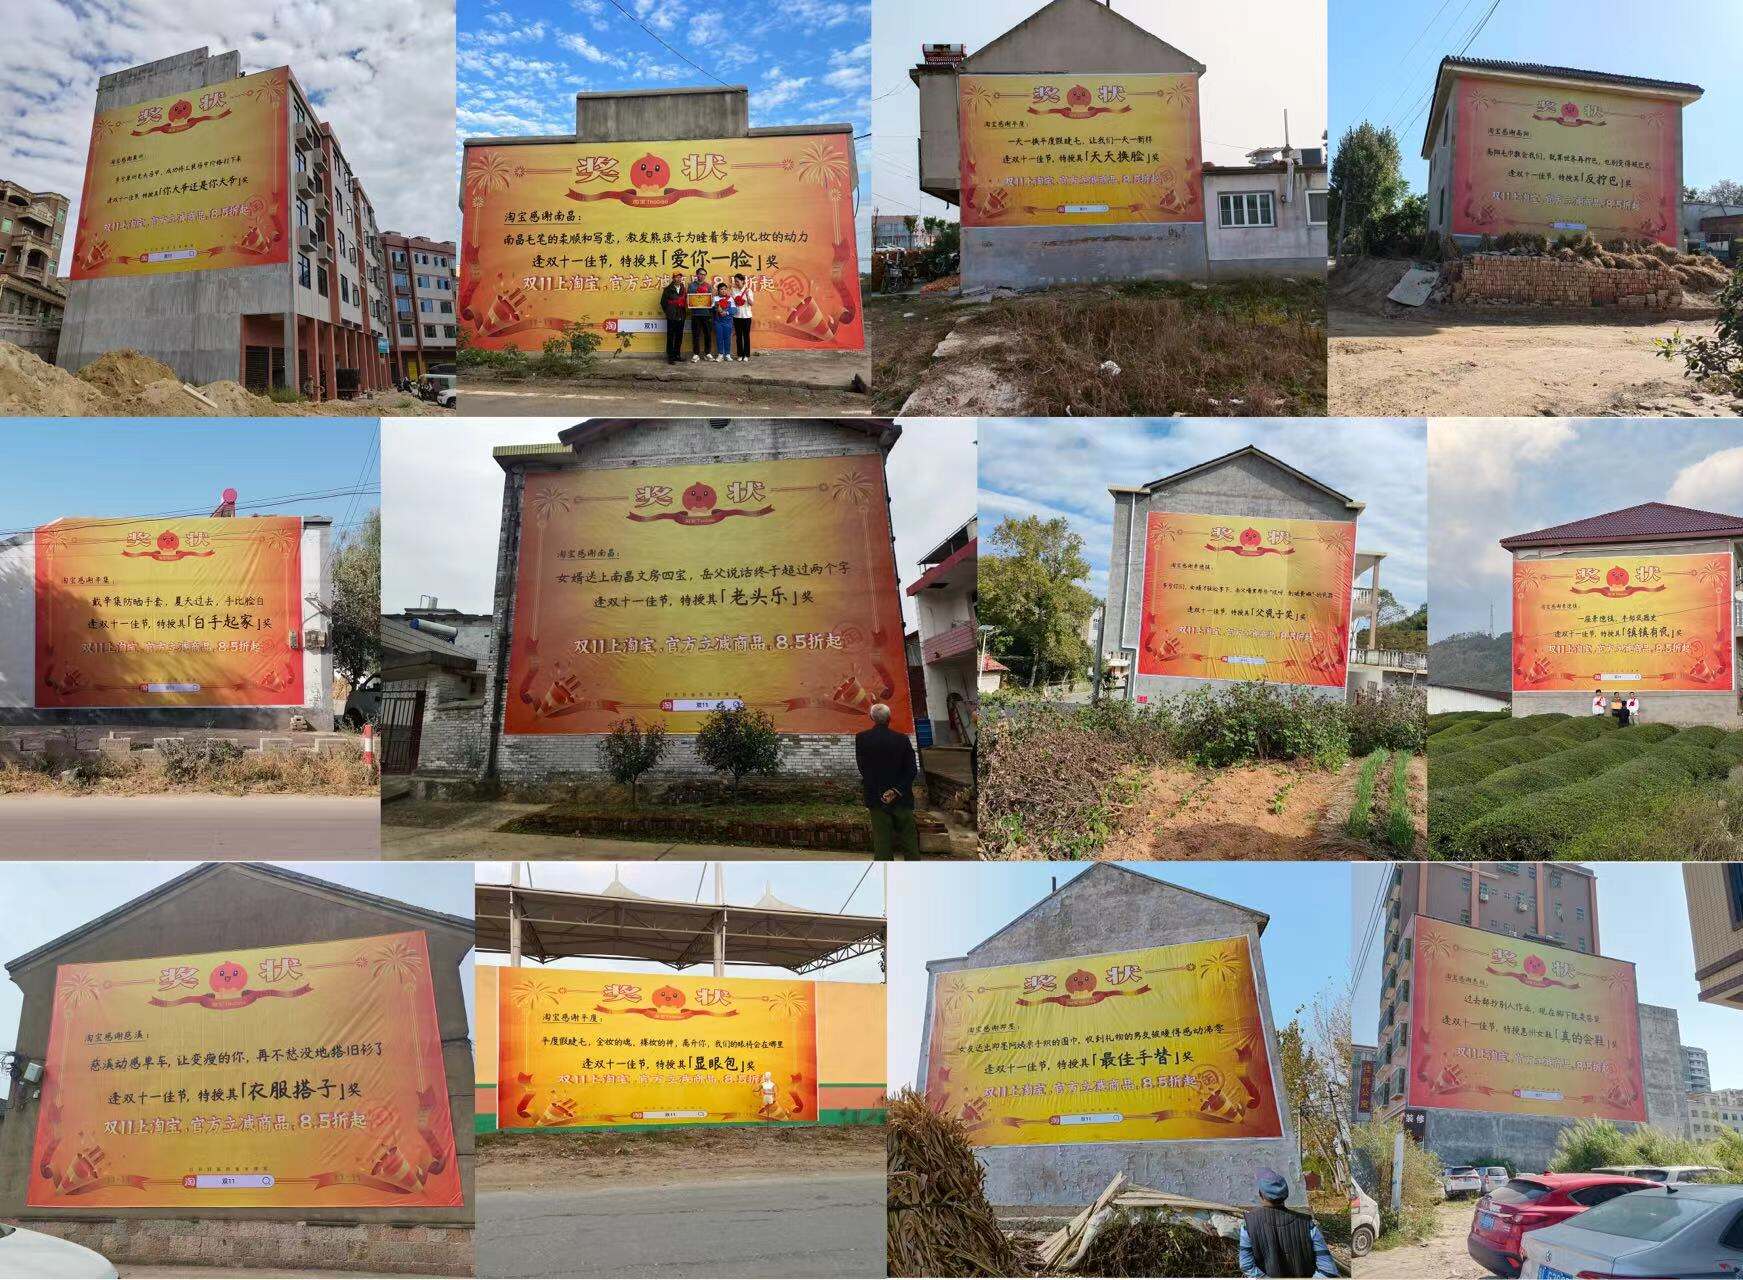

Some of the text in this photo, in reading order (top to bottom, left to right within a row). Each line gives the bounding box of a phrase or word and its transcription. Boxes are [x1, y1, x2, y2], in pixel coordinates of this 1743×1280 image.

[199, 91, 227, 111] 状
[1032, 85, 1127, 104] 奖 状
[575, 154, 727, 183] 奖 状
[504, 211, 582, 223] 淘宝感谢南昌：
[532, 248, 780, 271] 逢双十一佳节，特授其「爱你一脸」奖
[635, 481, 766, 508] 奖 状
[126, 531, 210, 547] 奖 状
[1210, 526, 1293, 545] 奖 状
[556, 548, 620, 559] 淘宝感谢南昌：
[1575, 565, 1661, 584] 奖 状
[593, 586, 815, 608] 逢双十一佳节，特授其「老头乐」奖
[87, 614, 271, 631] 逢双十一佳节，特授其「白手起家」奖
[1490, 946, 1576, 978] 奖 状
[158, 957, 303, 992] 奖 状
[1023, 964, 1142, 995] 奖 状
[601, 984, 733, 1007] 奖 状
[581, 1056, 756, 1072] 逢双十一佳节，特授其「显眼包」奖
[983, 1046, 1194, 1075] 逢双十一佳节，特授其「最佳手替」奖
[107, 1078, 361, 1105] 逢双十一佳节，特授其「衣服搭子」奖
[222, 1177, 235, 1185] 双11
